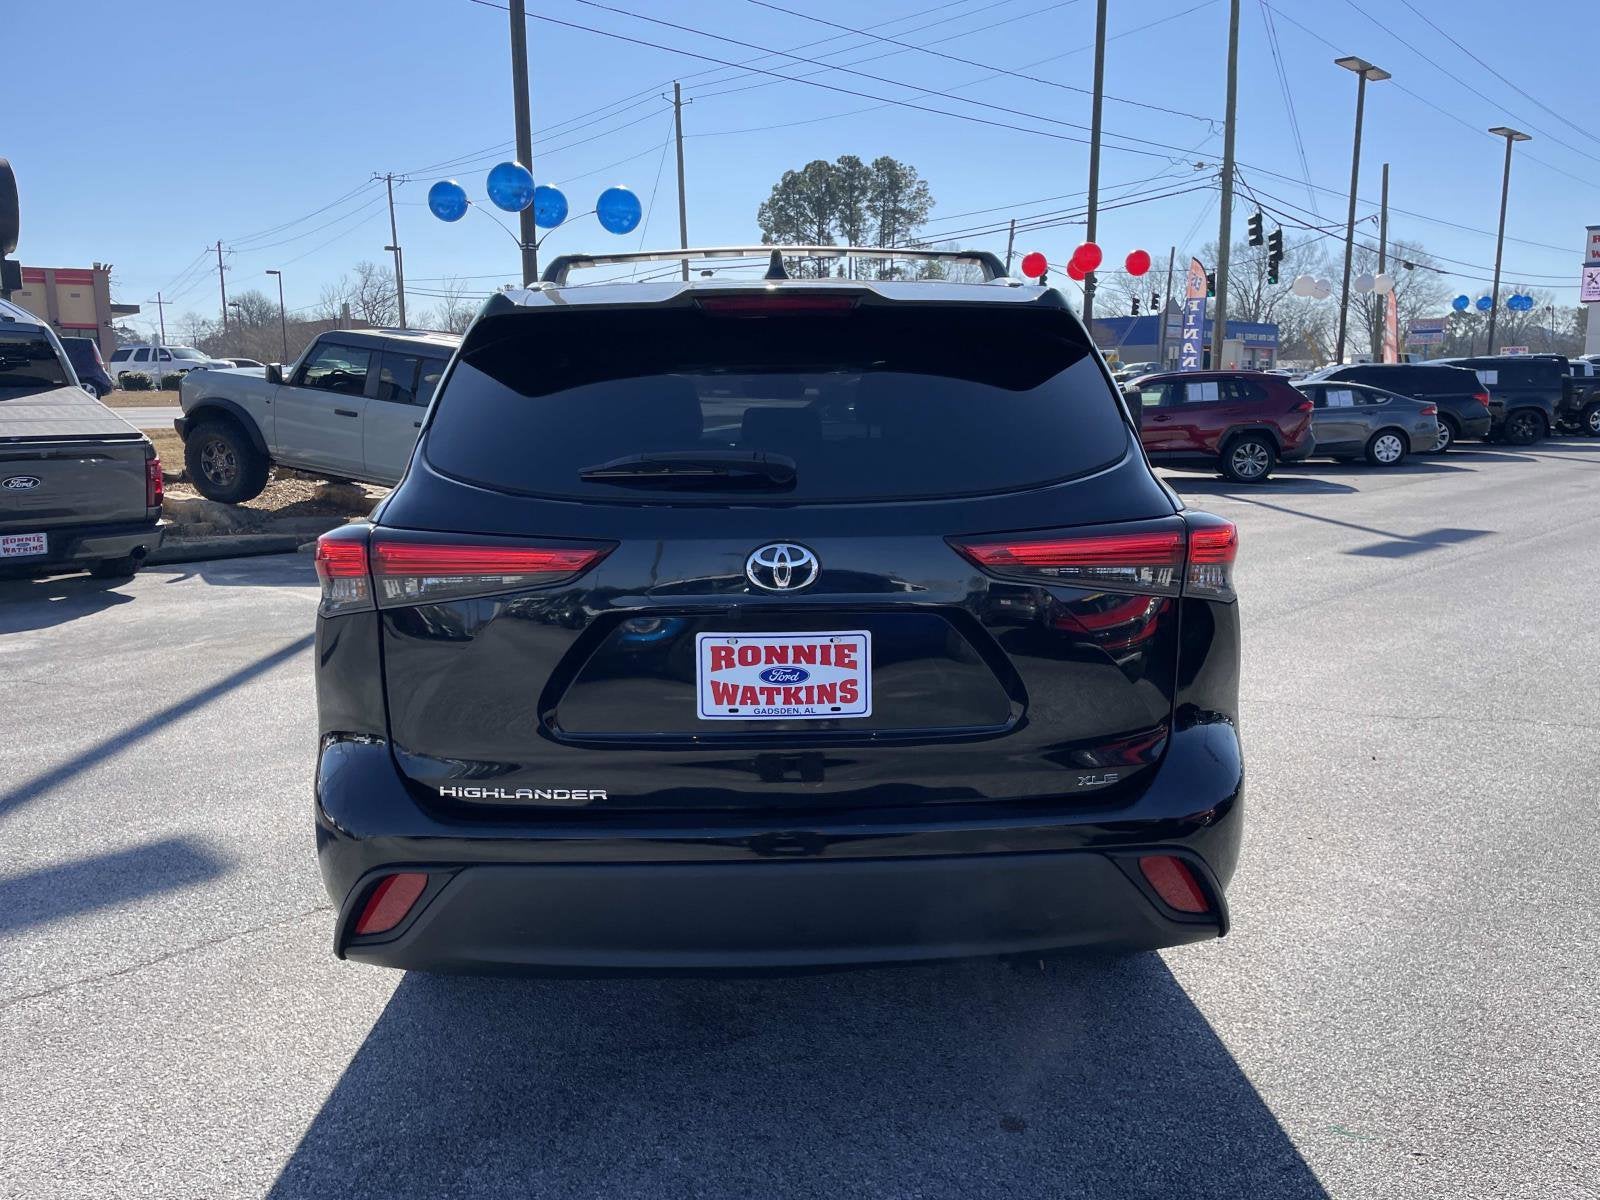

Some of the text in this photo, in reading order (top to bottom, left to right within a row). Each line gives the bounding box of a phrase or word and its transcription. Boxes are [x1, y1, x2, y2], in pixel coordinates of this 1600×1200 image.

[9, 479, 33, 488] Ford
[3, 544, 43, 553] WATKINS
[711, 644, 858, 672] RONNIE
[768, 669, 800, 682] Ford
[711, 679, 859, 706] WATKINS
[753, 707, 802, 715] GADSDEN,
[1078, 773, 1118, 785] XLE
[439, 786, 608, 800] HIGHLANDER
